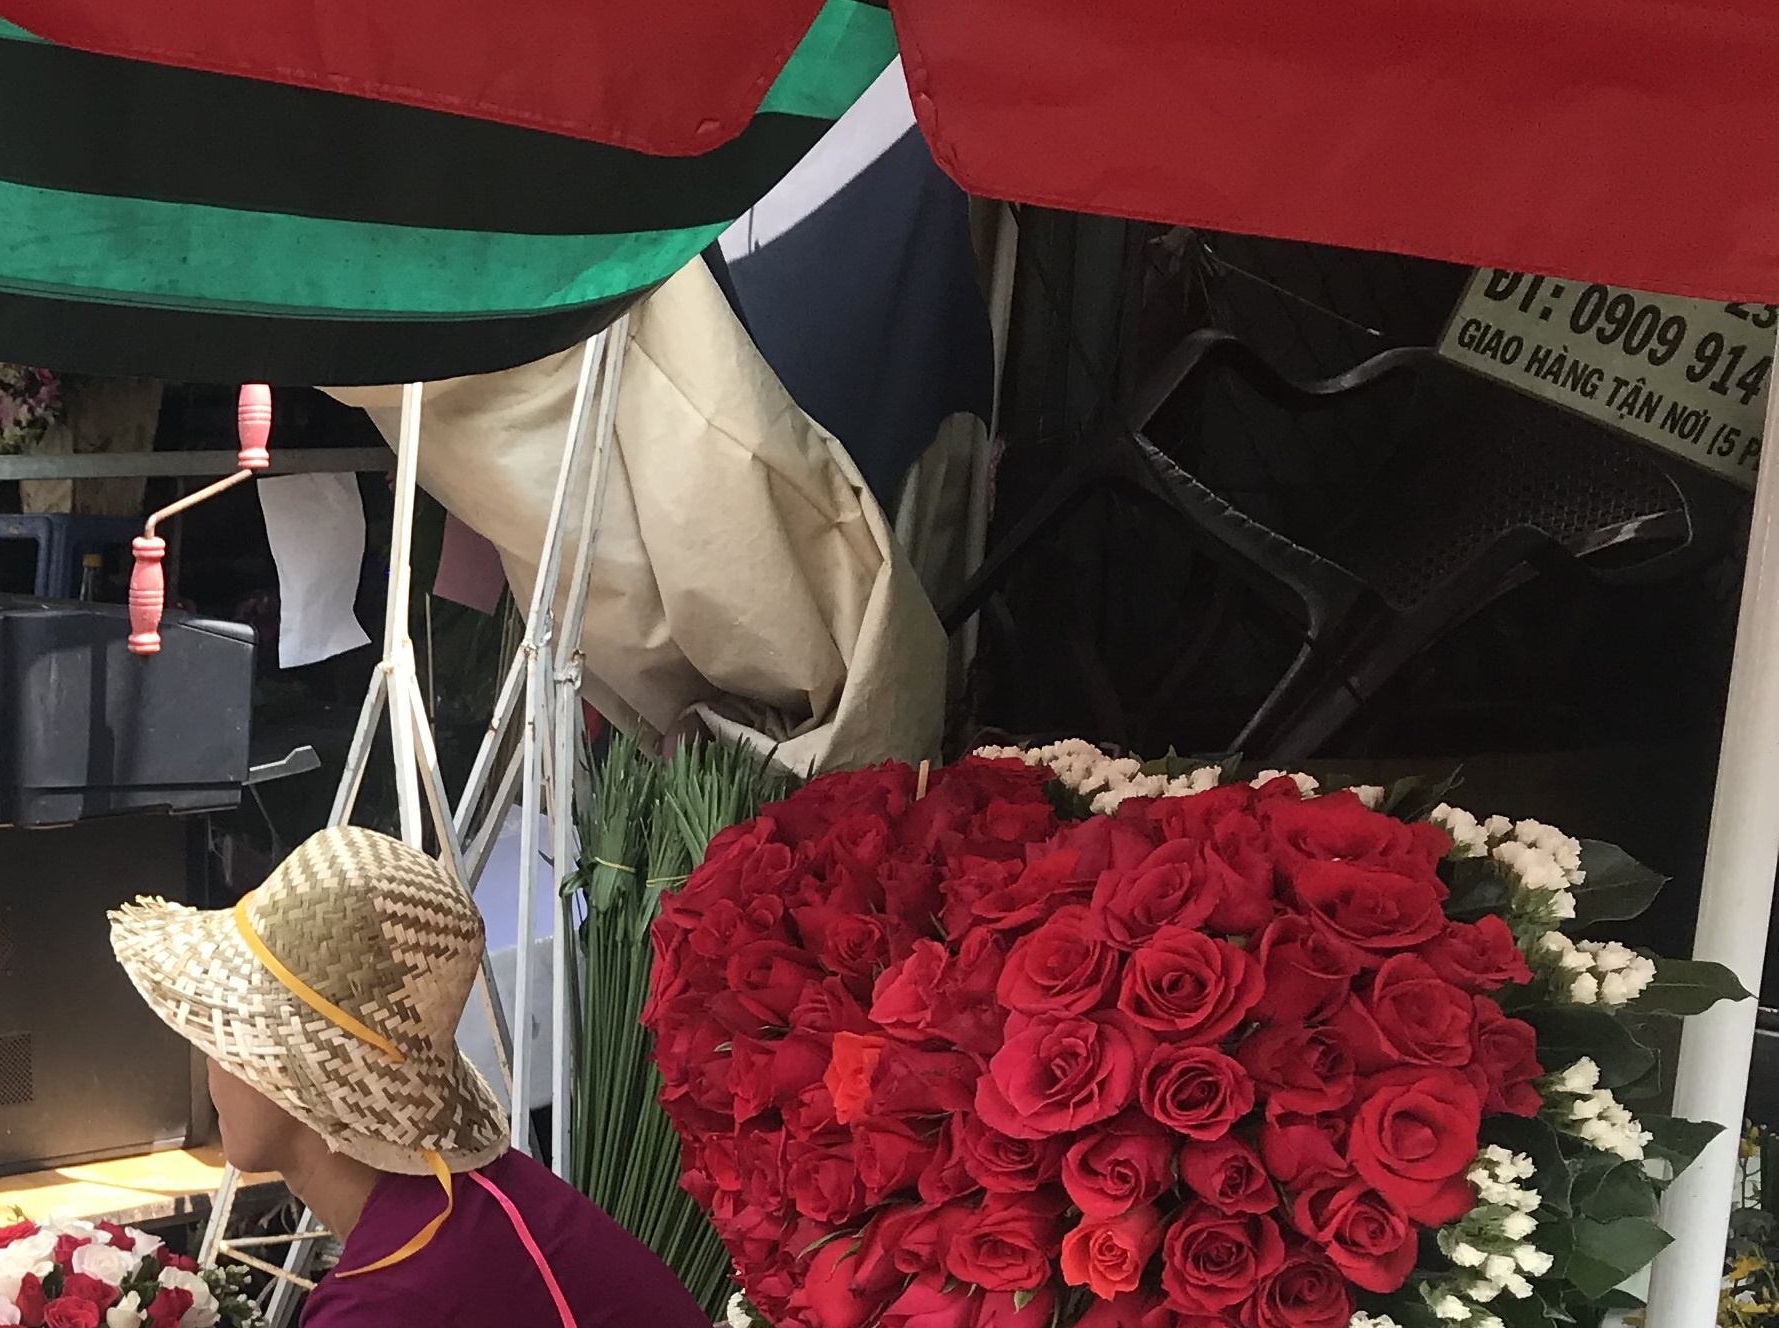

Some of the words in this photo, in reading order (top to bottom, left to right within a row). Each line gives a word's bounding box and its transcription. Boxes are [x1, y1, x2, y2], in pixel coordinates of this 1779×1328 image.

[1457, 318, 1524, 365] GIAO
[1524, 345, 1604, 399] HÀNG
[1606, 376, 1663, 424] TẬN
[1660, 401, 1711, 446] NƠI
[1570, 284, 1686, 366] 0909
[1685, 333, 1772, 406] 914
